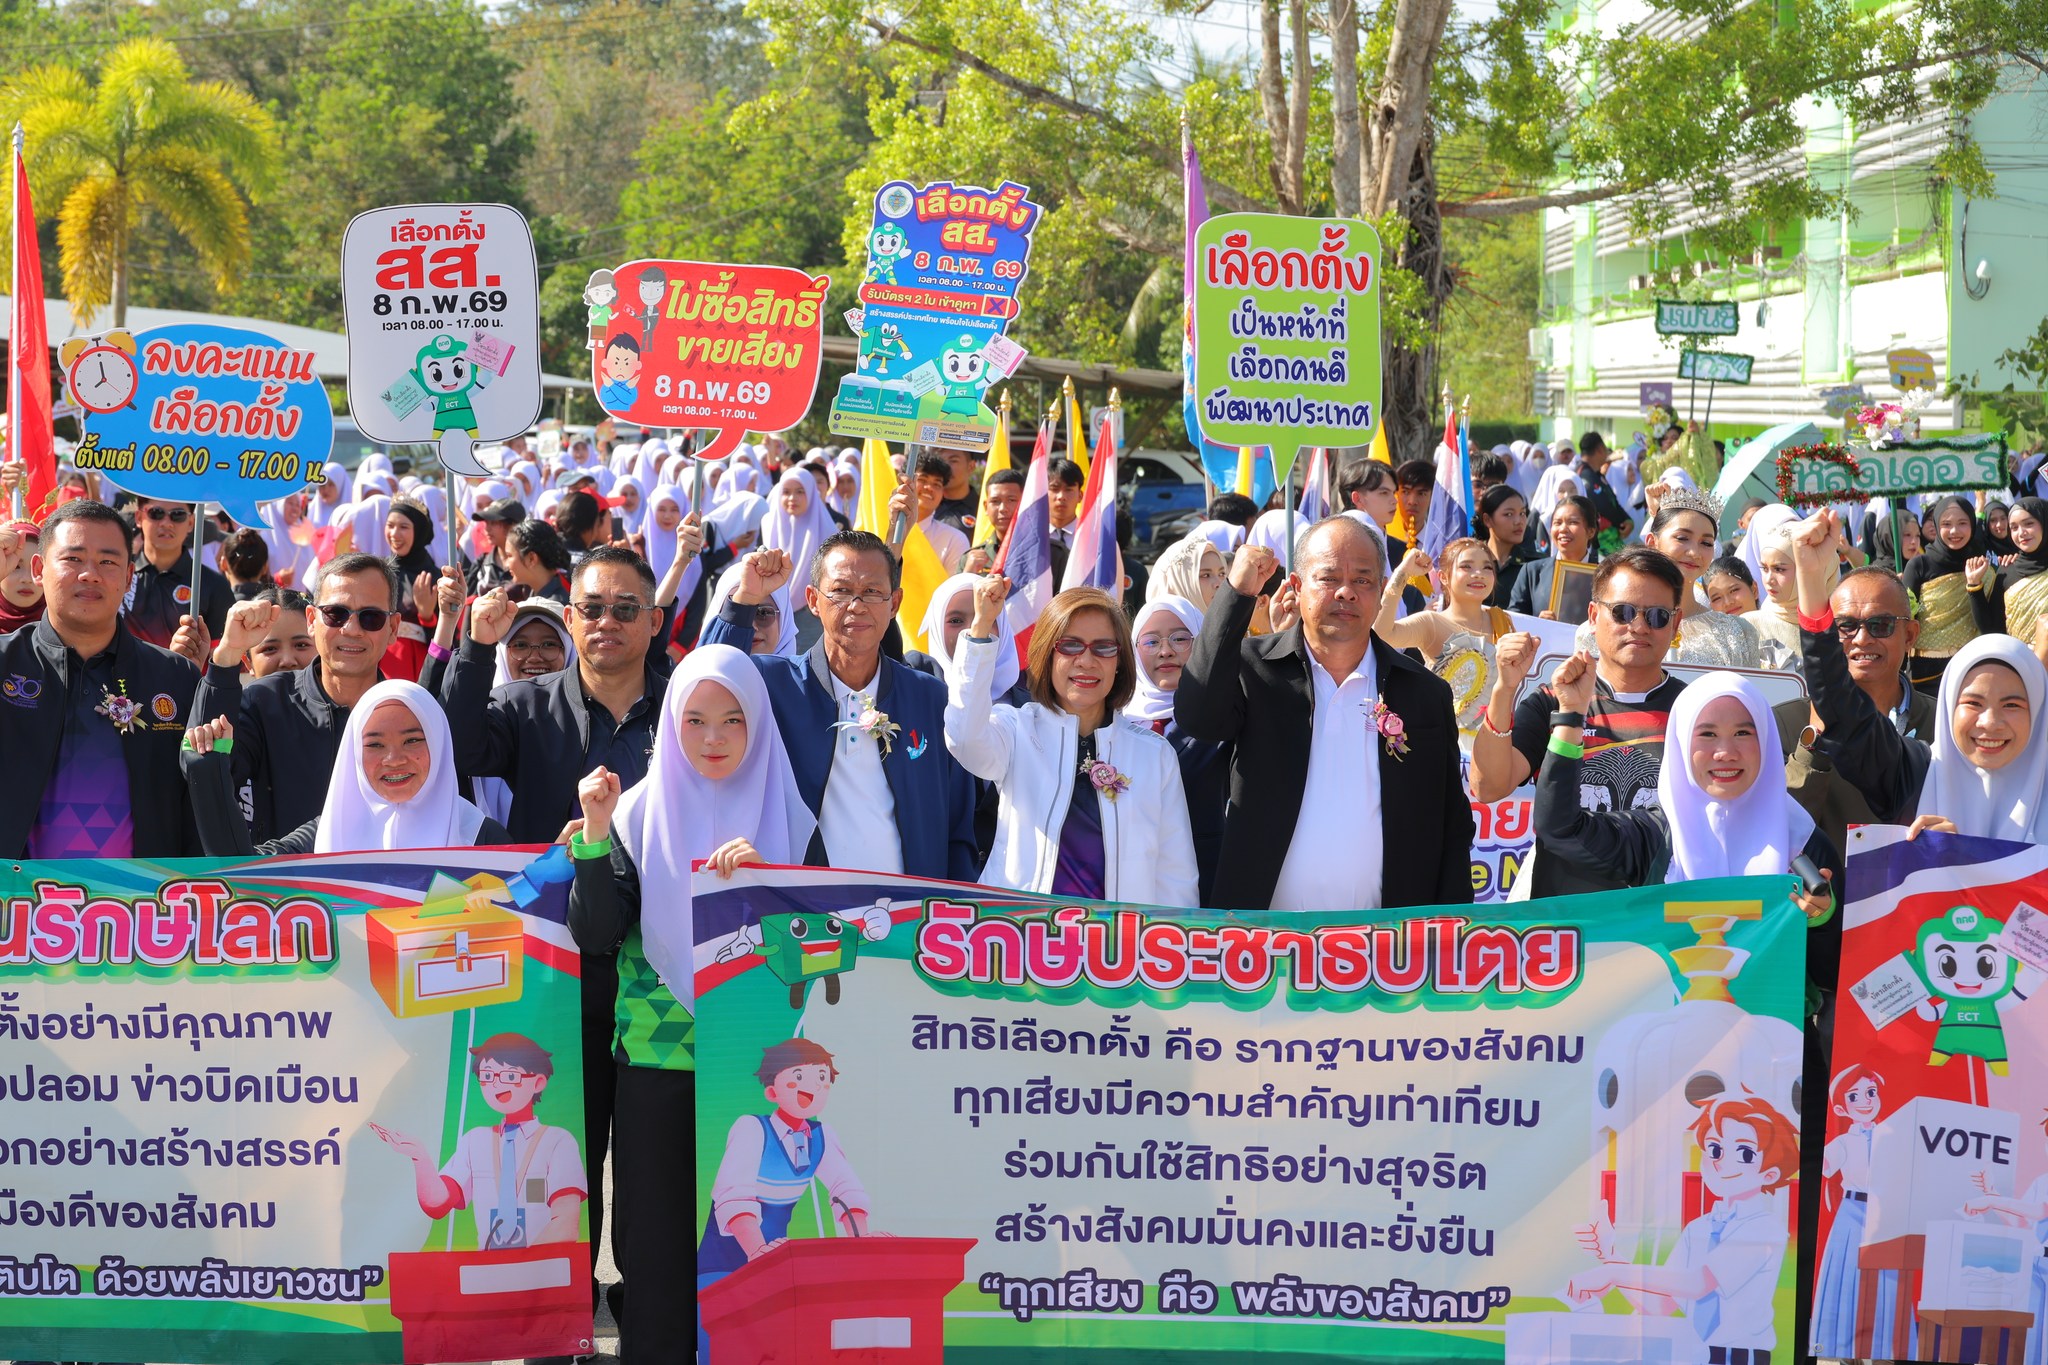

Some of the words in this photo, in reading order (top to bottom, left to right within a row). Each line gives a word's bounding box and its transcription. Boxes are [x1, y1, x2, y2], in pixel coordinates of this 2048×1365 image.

[391, 210, 486, 243] เลือกตั้ง
[917, 188, 1029, 226] เลือกตั้ง
[942, 221, 996, 247] สส.
[375, 243, 501, 291] สส.
[915, 252, 929, 269] 8
[938, 256, 983, 275] ก.พ.
[993, 260, 1022, 279] 69
[1208, 227, 1369, 291] เลือกตั้ง
[373, 294, 392, 316] 8
[400, 290, 508, 315] ก.พ.69
[666, 271, 827, 328] ไม่ซื้อสิทธิ์
[866, 287, 912, 304] รับบัตรฯ
[914, 294, 922, 306] 2
[924, 293, 936, 306] ใบ
[938, 294, 977, 313] เข้าคูหา
[918, 276, 938, 285] เวลา
[939, 278, 963, 288] 08.00
[972, 281, 996, 291] 17.00
[997, 284, 1006, 292] น.
[382, 321, 408, 331] เวลา
[410, 319, 444, 330] 08.00
[456, 318, 489, 329] 17.00
[492, 319, 504, 327] น.
[1232, 298, 1345, 340] เป็นหน้าที่
[145, 342, 316, 382] ลงคะแนน
[677, 330, 804, 369] ขายเสียง
[1231, 346, 1345, 382] เลือกคนดี
[445, 401, 459, 409] ECT
[654, 374, 671, 398] 8
[678, 378, 771, 405] ก.พ.69
[1206, 389, 1370, 427] พัฒนาประเทศ
[152, 385, 299, 438] เลือกตั้ง
[662, 404, 682, 414] เวลา
[684, 405, 711, 416] 08.00
[720, 408, 747, 419] 17.00
[748, 411, 758, 420] น.
[75, 434, 136, 471] ตั้งแต่
[142, 443, 210, 476] 08.00
[238, 449, 300, 482] 17.00
[305, 461, 328, 484] น.
[921, 902, 1576, 990] รักษ์ประชาธิปไตย
[1871, 974, 1903, 1000] บัตรเลือกตั้ง
[1956, 1012, 1980, 1022] ECT
[911, 1014, 1150, 1061] สิทธิเลือกตั้ง
[1165, 1028, 1222, 1063] คือ
[1236, 1027, 1585, 1071] รากฐานของสังคม
[131, 1063, 359, 1103] ข่าวบิดเบือน
[952, 1075, 1541, 1128] ทุกเสียงมีความสำคัญเท่าเทียม
[1919, 1125, 2012, 1165] VOTE
[1003, 1138, 1488, 1199] ร่วมกันใช้สิทธิอย่างสุจริต
[995, 1195, 1495, 1257] สร้างสังคมมั่นคงและยั่งยืน
[1161, 1273, 1216, 1312] คือ
